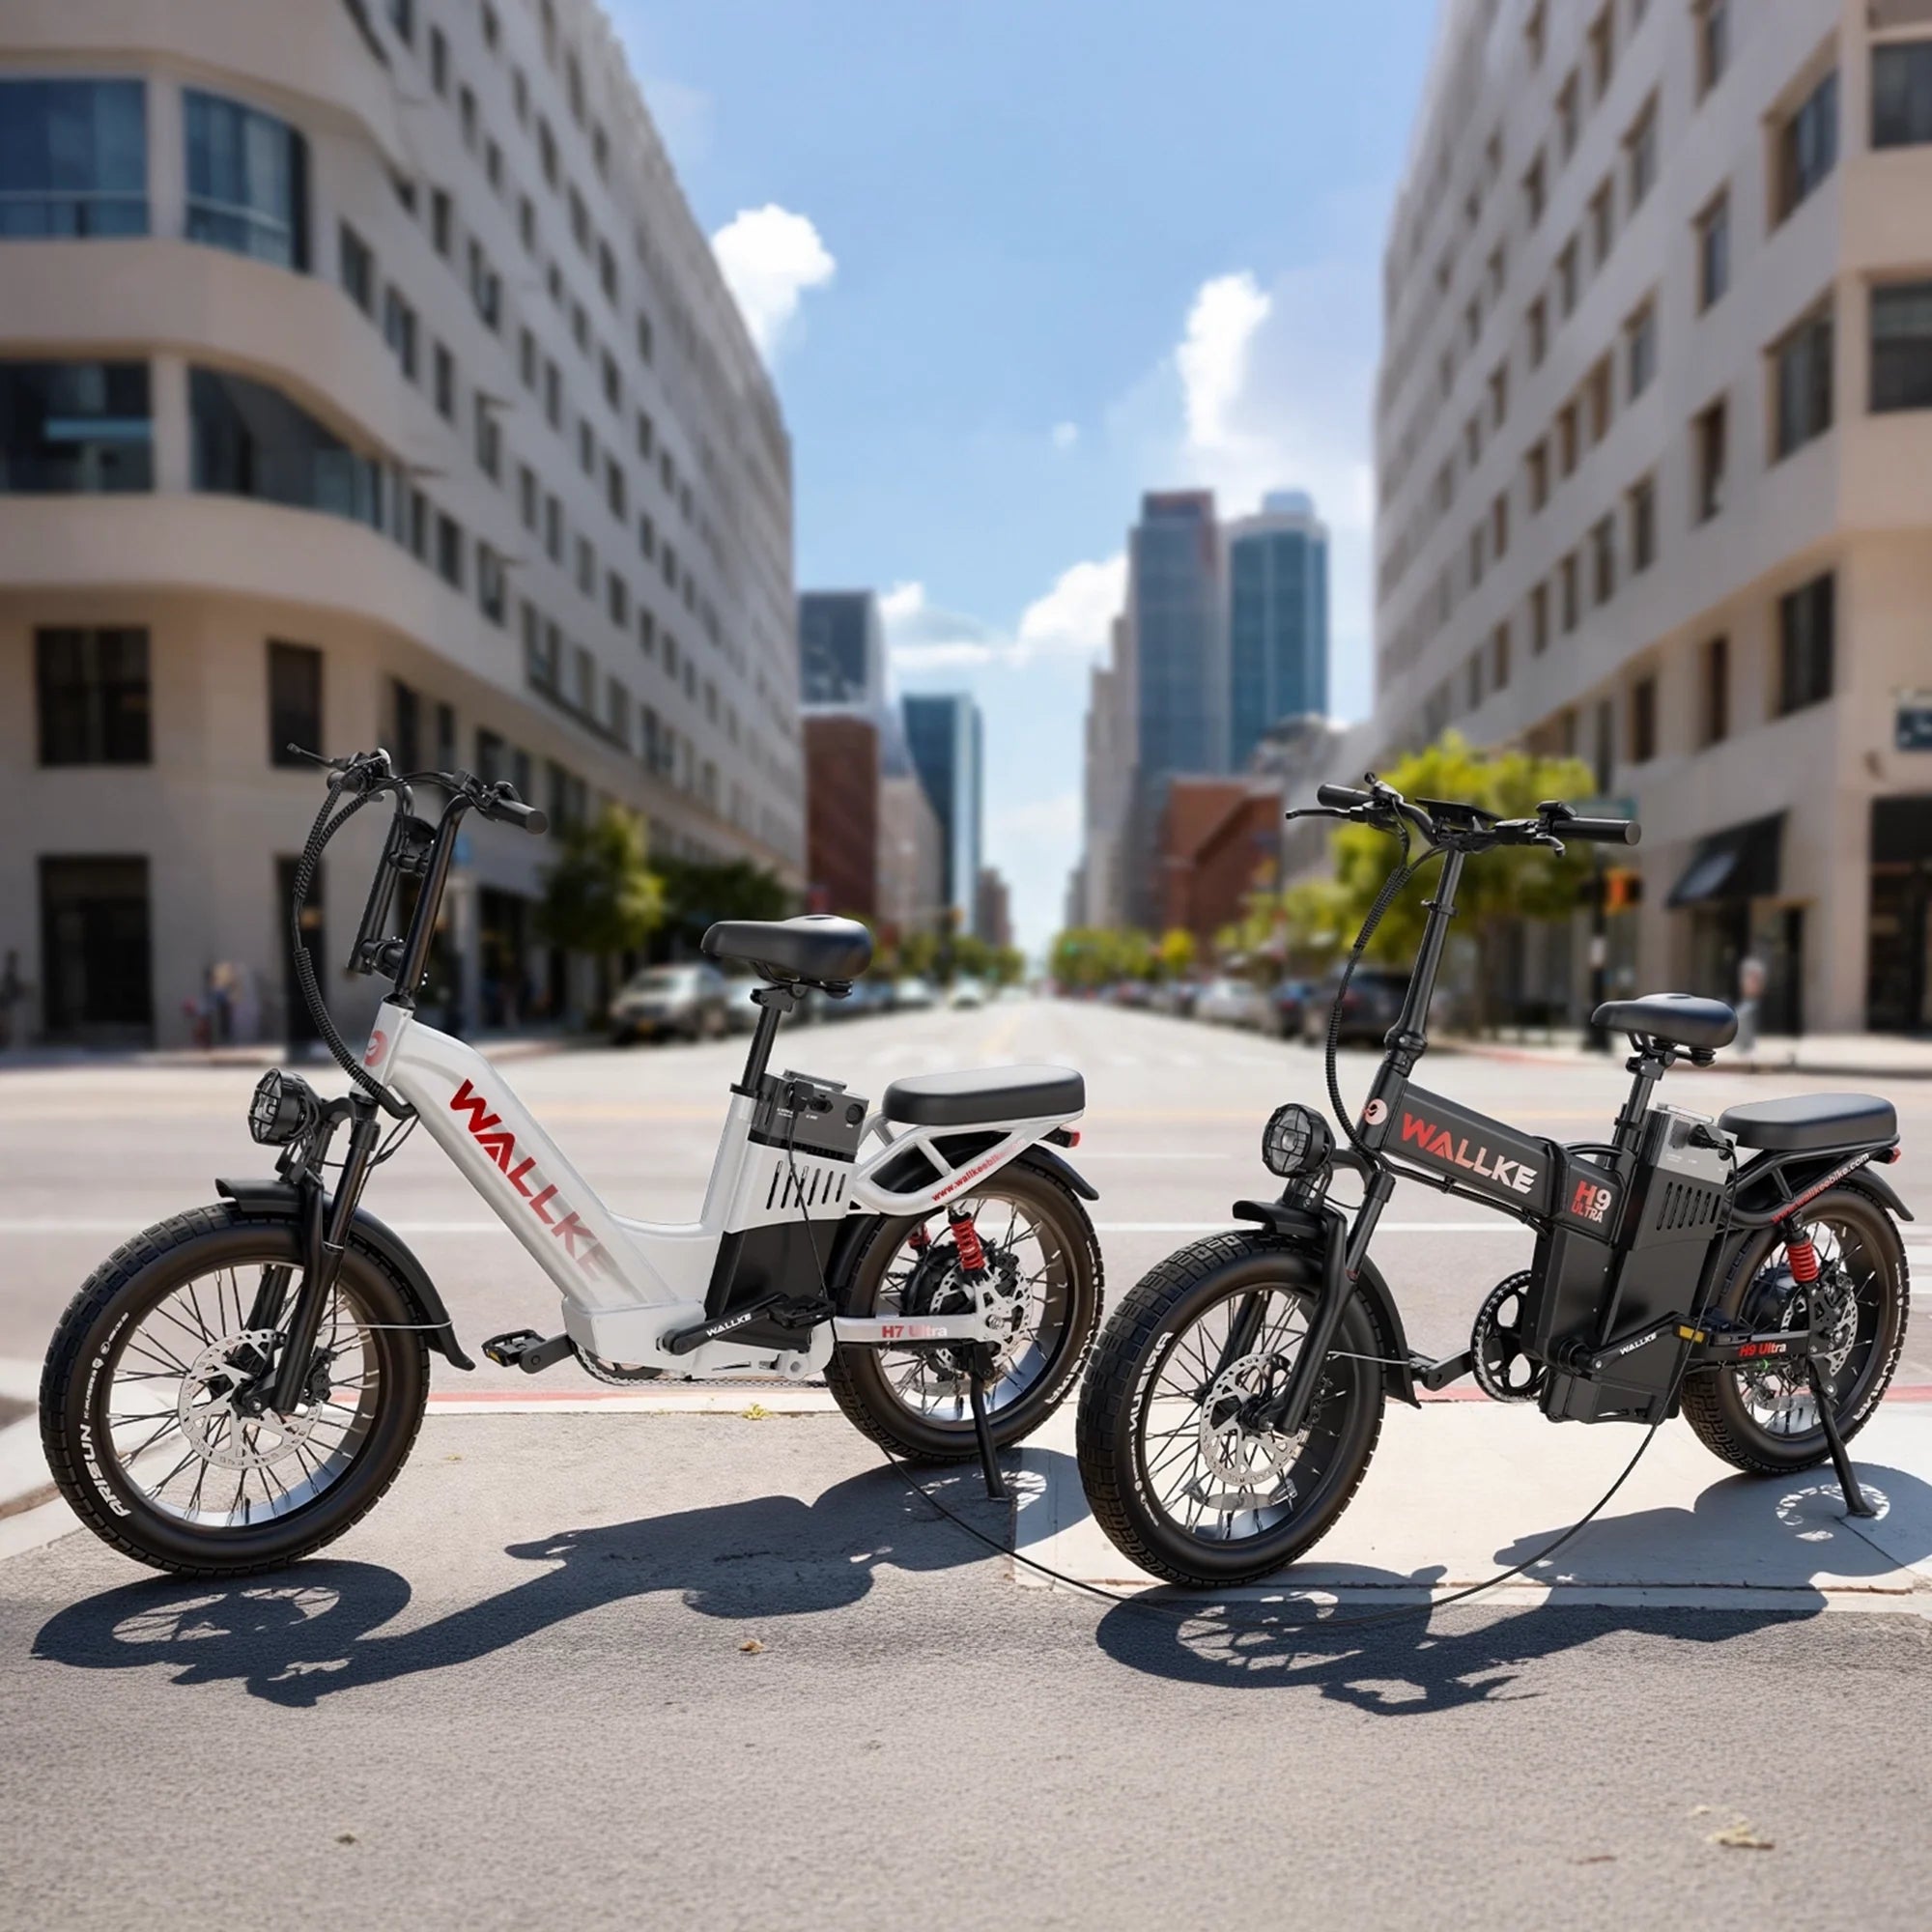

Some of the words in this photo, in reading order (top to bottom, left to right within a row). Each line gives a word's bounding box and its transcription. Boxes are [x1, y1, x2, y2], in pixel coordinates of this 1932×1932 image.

[1403, 1113, 1538, 1194] WALLKE
[450, 1078, 611, 1282] WALLKE
[932, 1139, 1026, 1202] www.wallkeebikom
[1575, 1180, 1611, 1210] H9
[1572, 1200, 1604, 1223] ULTRA
[706, 1313, 752, 1337] WALLKE
[882, 1325, 904, 1338] H7
[908, 1324, 948, 1338] Ultra
[1619, 1332, 1657, 1355] WALLKE
[1739, 1343, 1756, 1356] H9
[1758, 1342, 1787, 1354] Ultra
[80, 1424, 131, 1517] ARISUN
